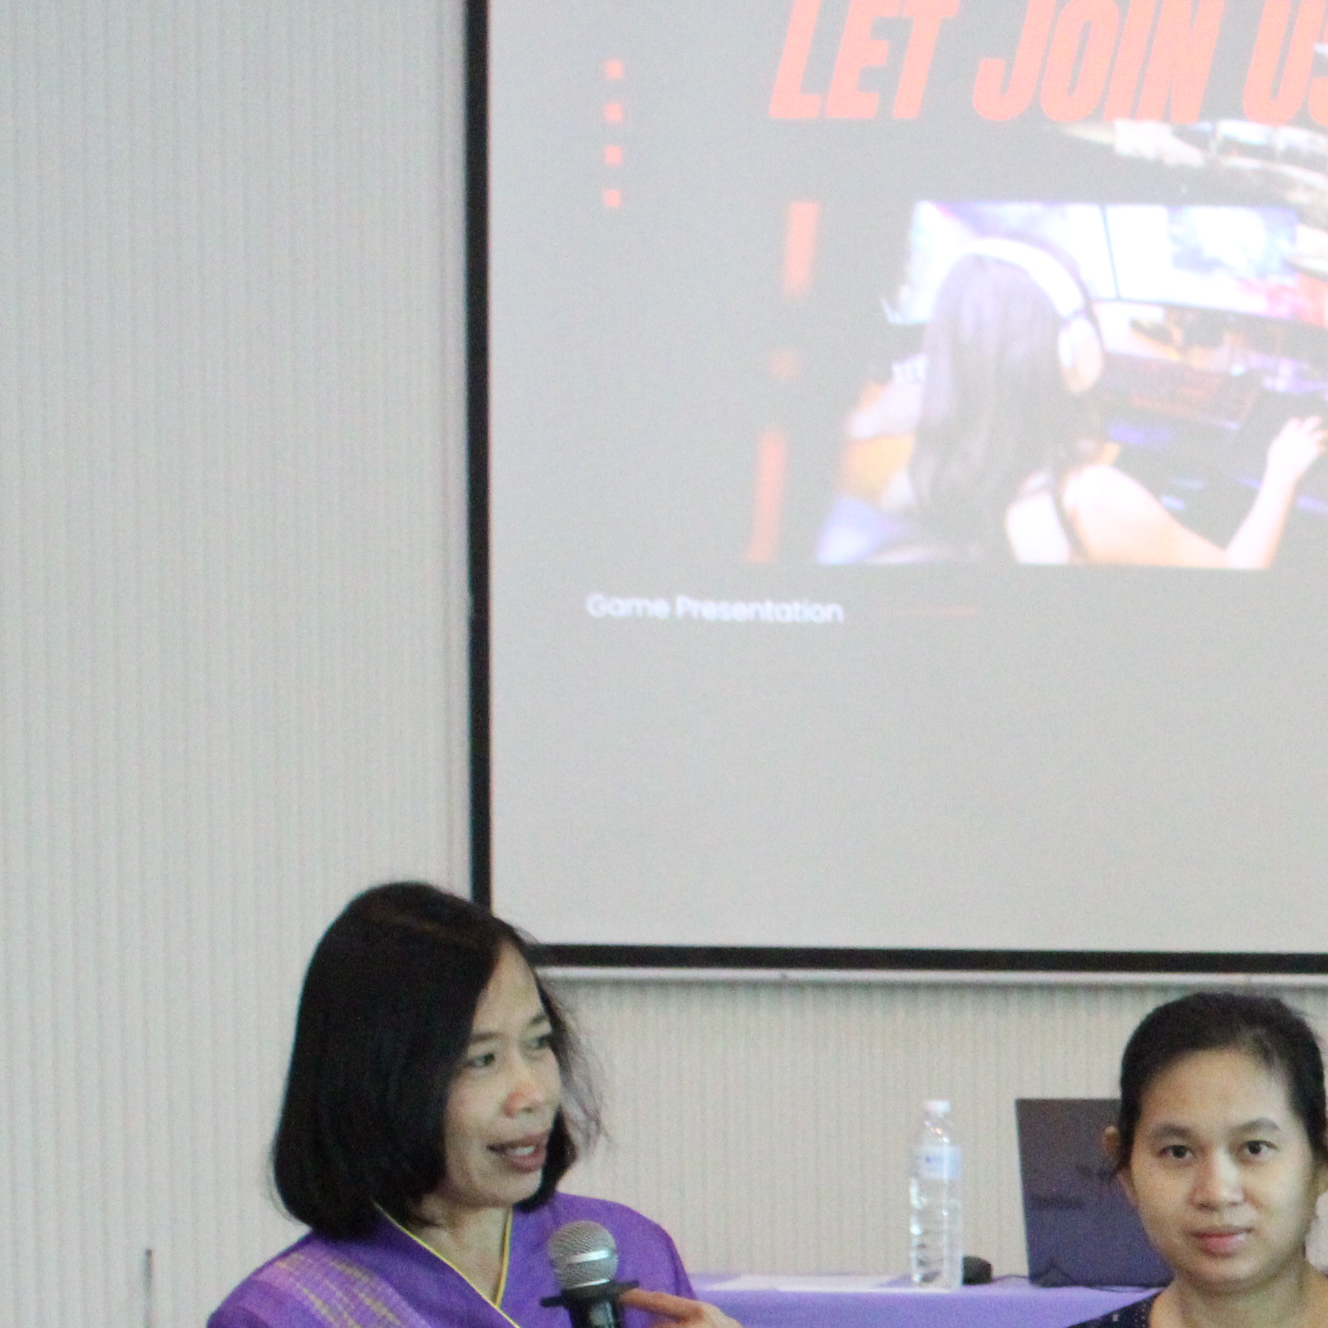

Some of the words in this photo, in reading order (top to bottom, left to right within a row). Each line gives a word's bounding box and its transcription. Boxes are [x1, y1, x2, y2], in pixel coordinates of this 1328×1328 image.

[768, 0, 961, 119] LET
[972, 0, 1225, 122] JOIN
[586, 593, 670, 620] Game
[675, 594, 846, 625] Presentation
